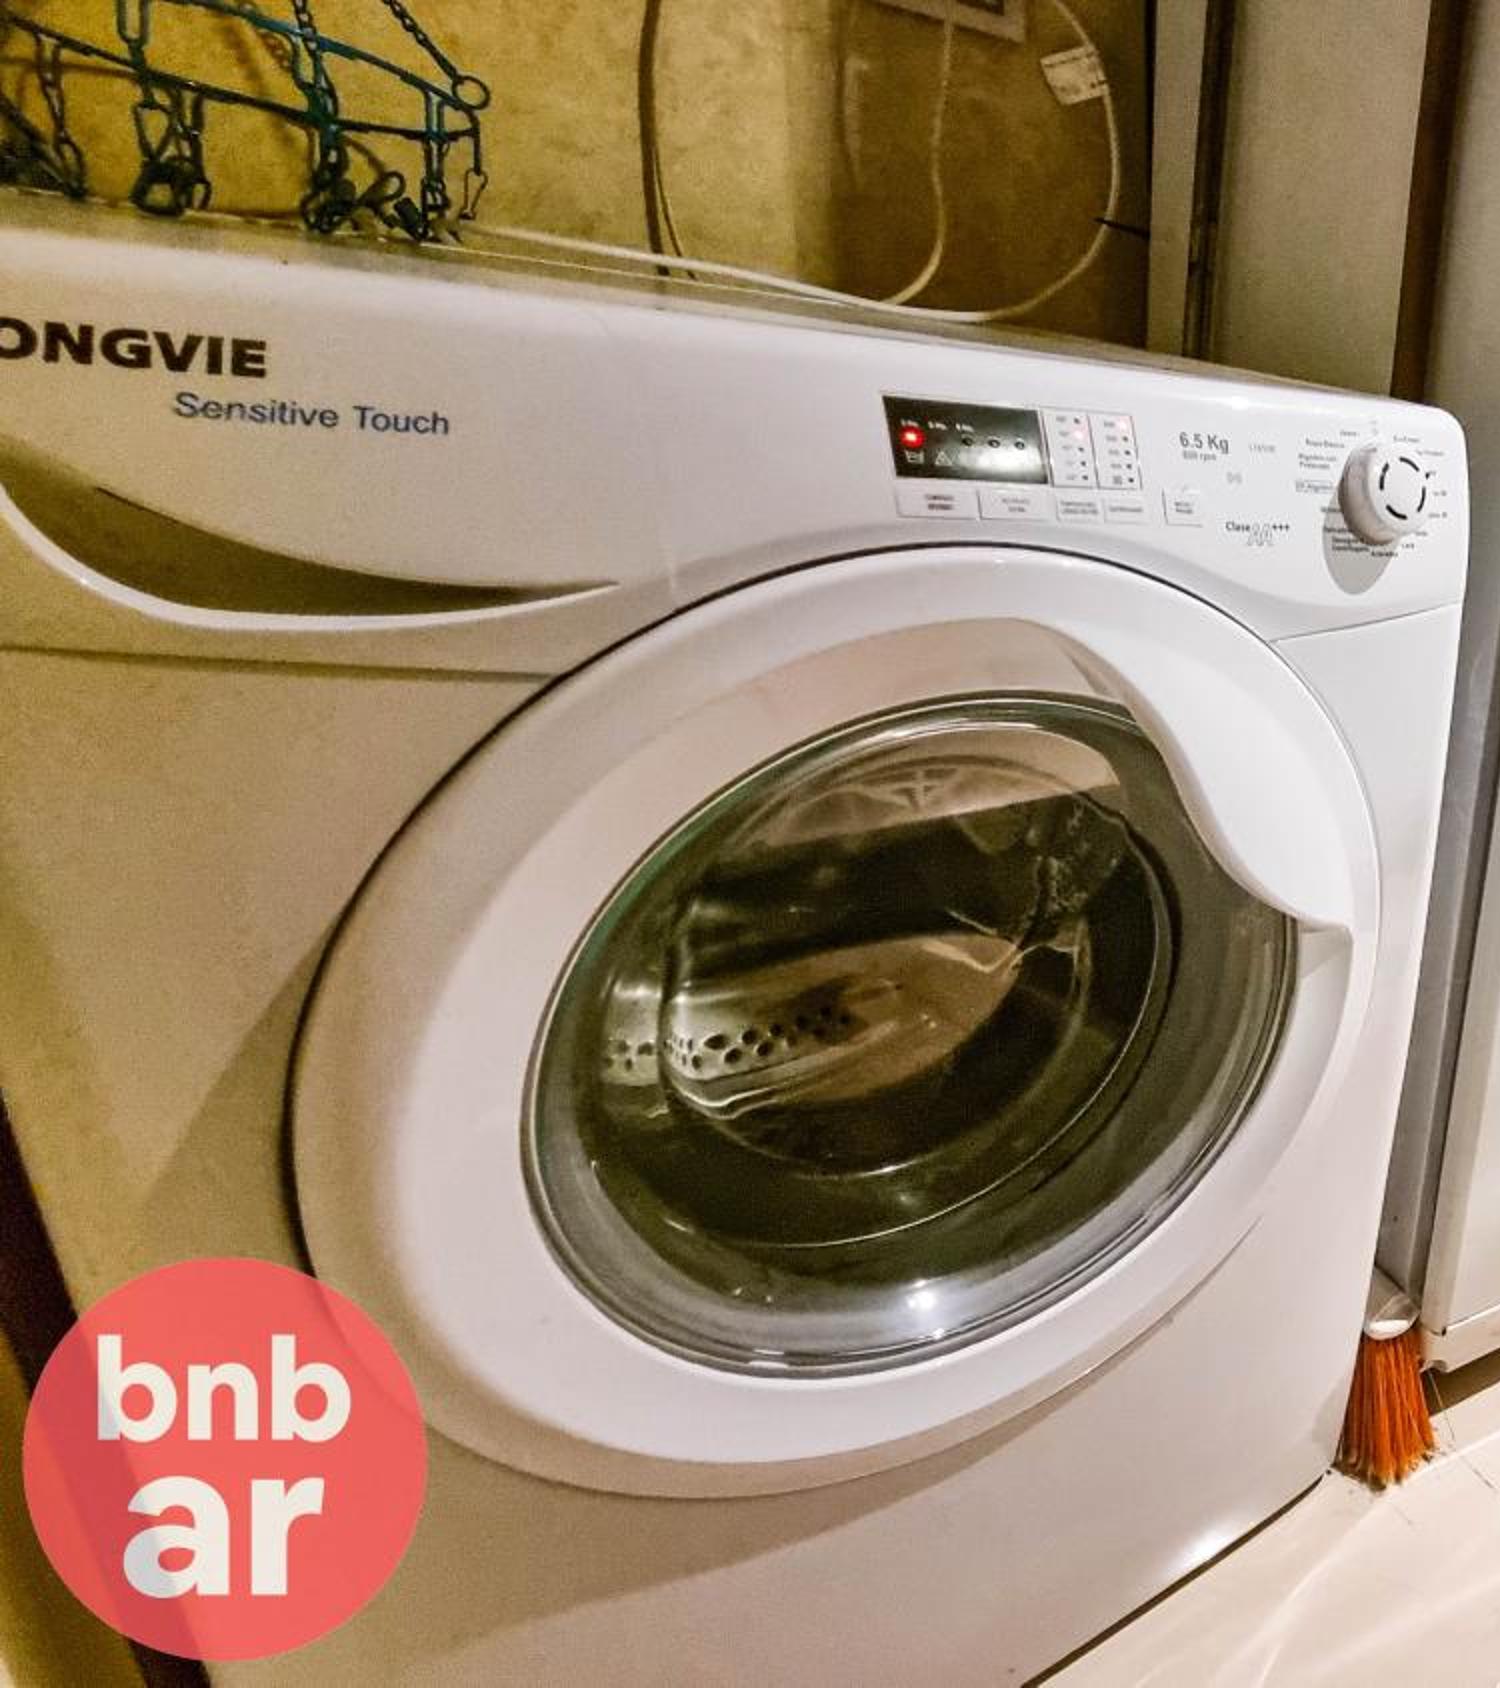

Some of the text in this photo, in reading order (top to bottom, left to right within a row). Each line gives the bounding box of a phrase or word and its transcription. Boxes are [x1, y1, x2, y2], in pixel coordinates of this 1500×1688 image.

[174, 391, 450, 434] Sensitive Touch
[1179, 431, 1204, 449] 6.5
[1207, 434, 1230, 455] Kg
